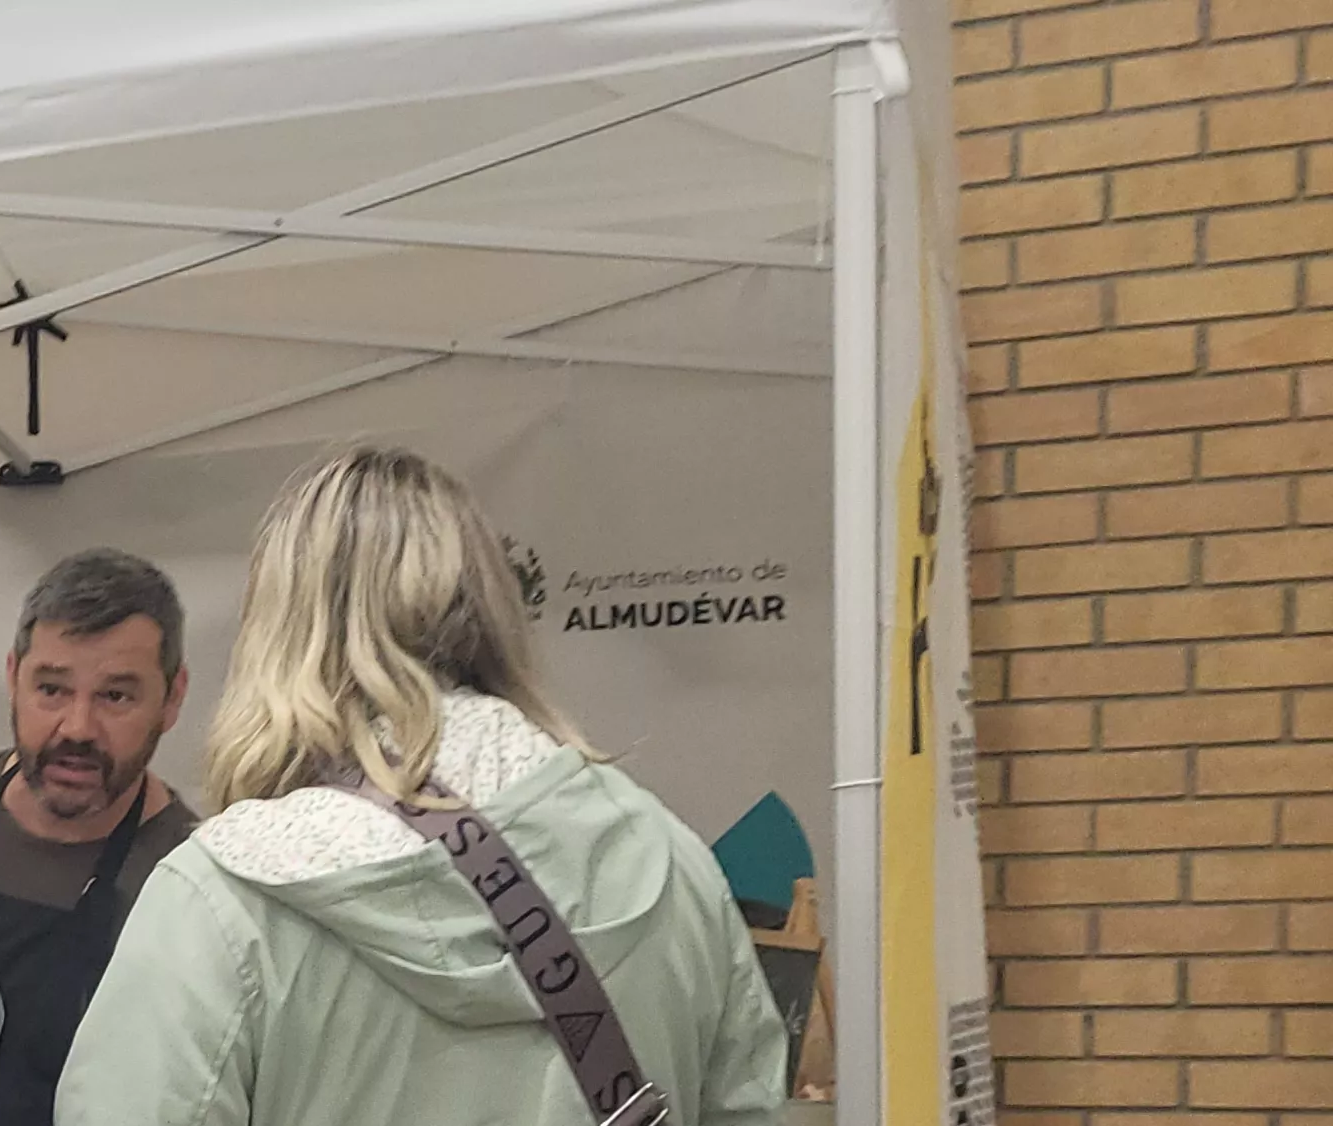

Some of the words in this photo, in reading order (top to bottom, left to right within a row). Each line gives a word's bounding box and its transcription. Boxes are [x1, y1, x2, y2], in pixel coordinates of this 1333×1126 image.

[563, 562, 742, 596] Ayuntamiento
[751, 558, 787, 581] de
[562, 591, 786, 632] ALMUDÉVAR
